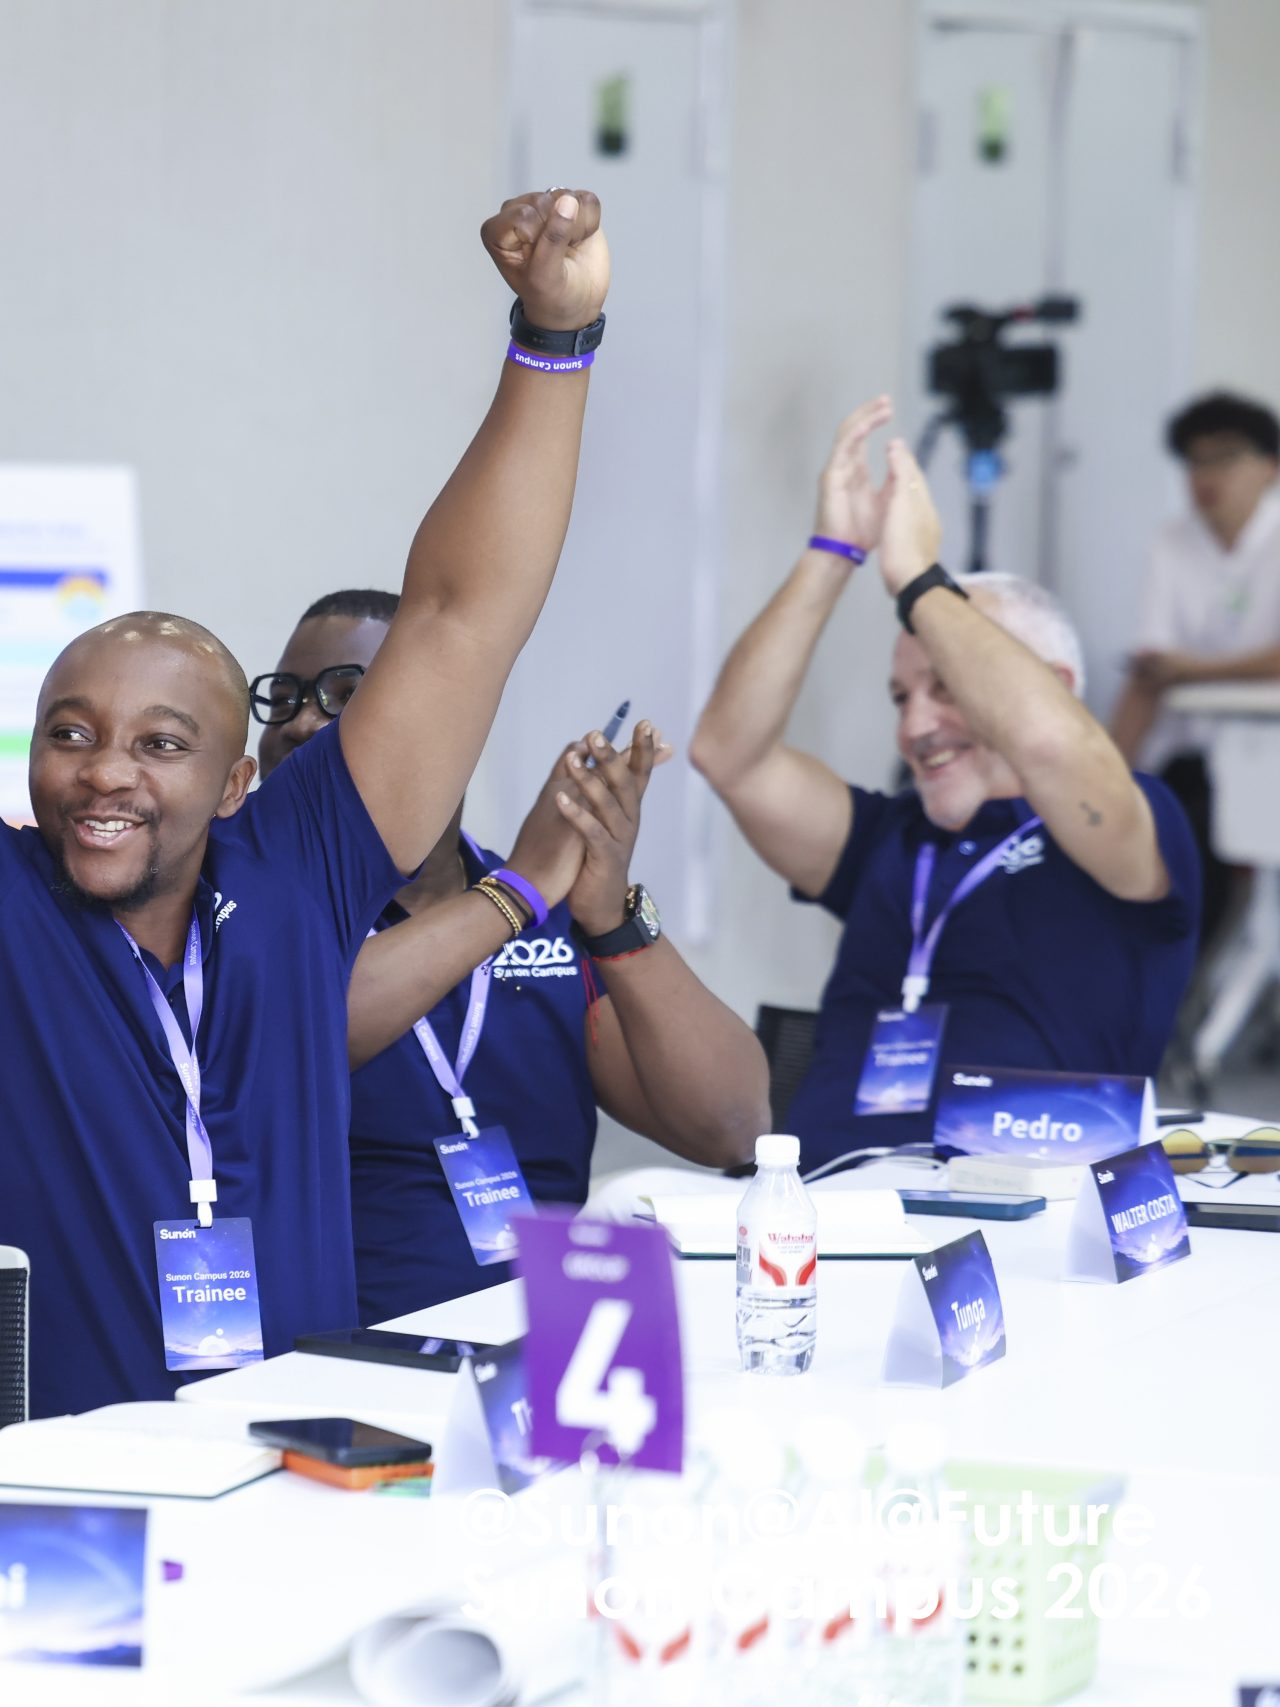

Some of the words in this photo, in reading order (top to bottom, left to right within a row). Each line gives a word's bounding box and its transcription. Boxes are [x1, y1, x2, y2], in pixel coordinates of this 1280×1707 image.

[515, 353, 551, 371] Campus
[553, 360, 583, 370] Sunon
[492, 937, 574, 967] 2026
[531, 966, 578, 978] Campus
[992, 1111, 1083, 1142] Pedro
[462, 1186, 520, 1207] Trainee
[1110, 1204, 1151, 1234] WALTER
[1147, 1193, 1178, 1220] COSTA
[166, 1273, 192, 1281] Sunon
[194, 1272, 227, 1281] Campus
[229, 1270, 250, 1279] 2026
[172, 1285, 246, 1303] Trainee
[951, 1297, 986, 1332] Tunga
[556, 1298, 658, 1458] 4
